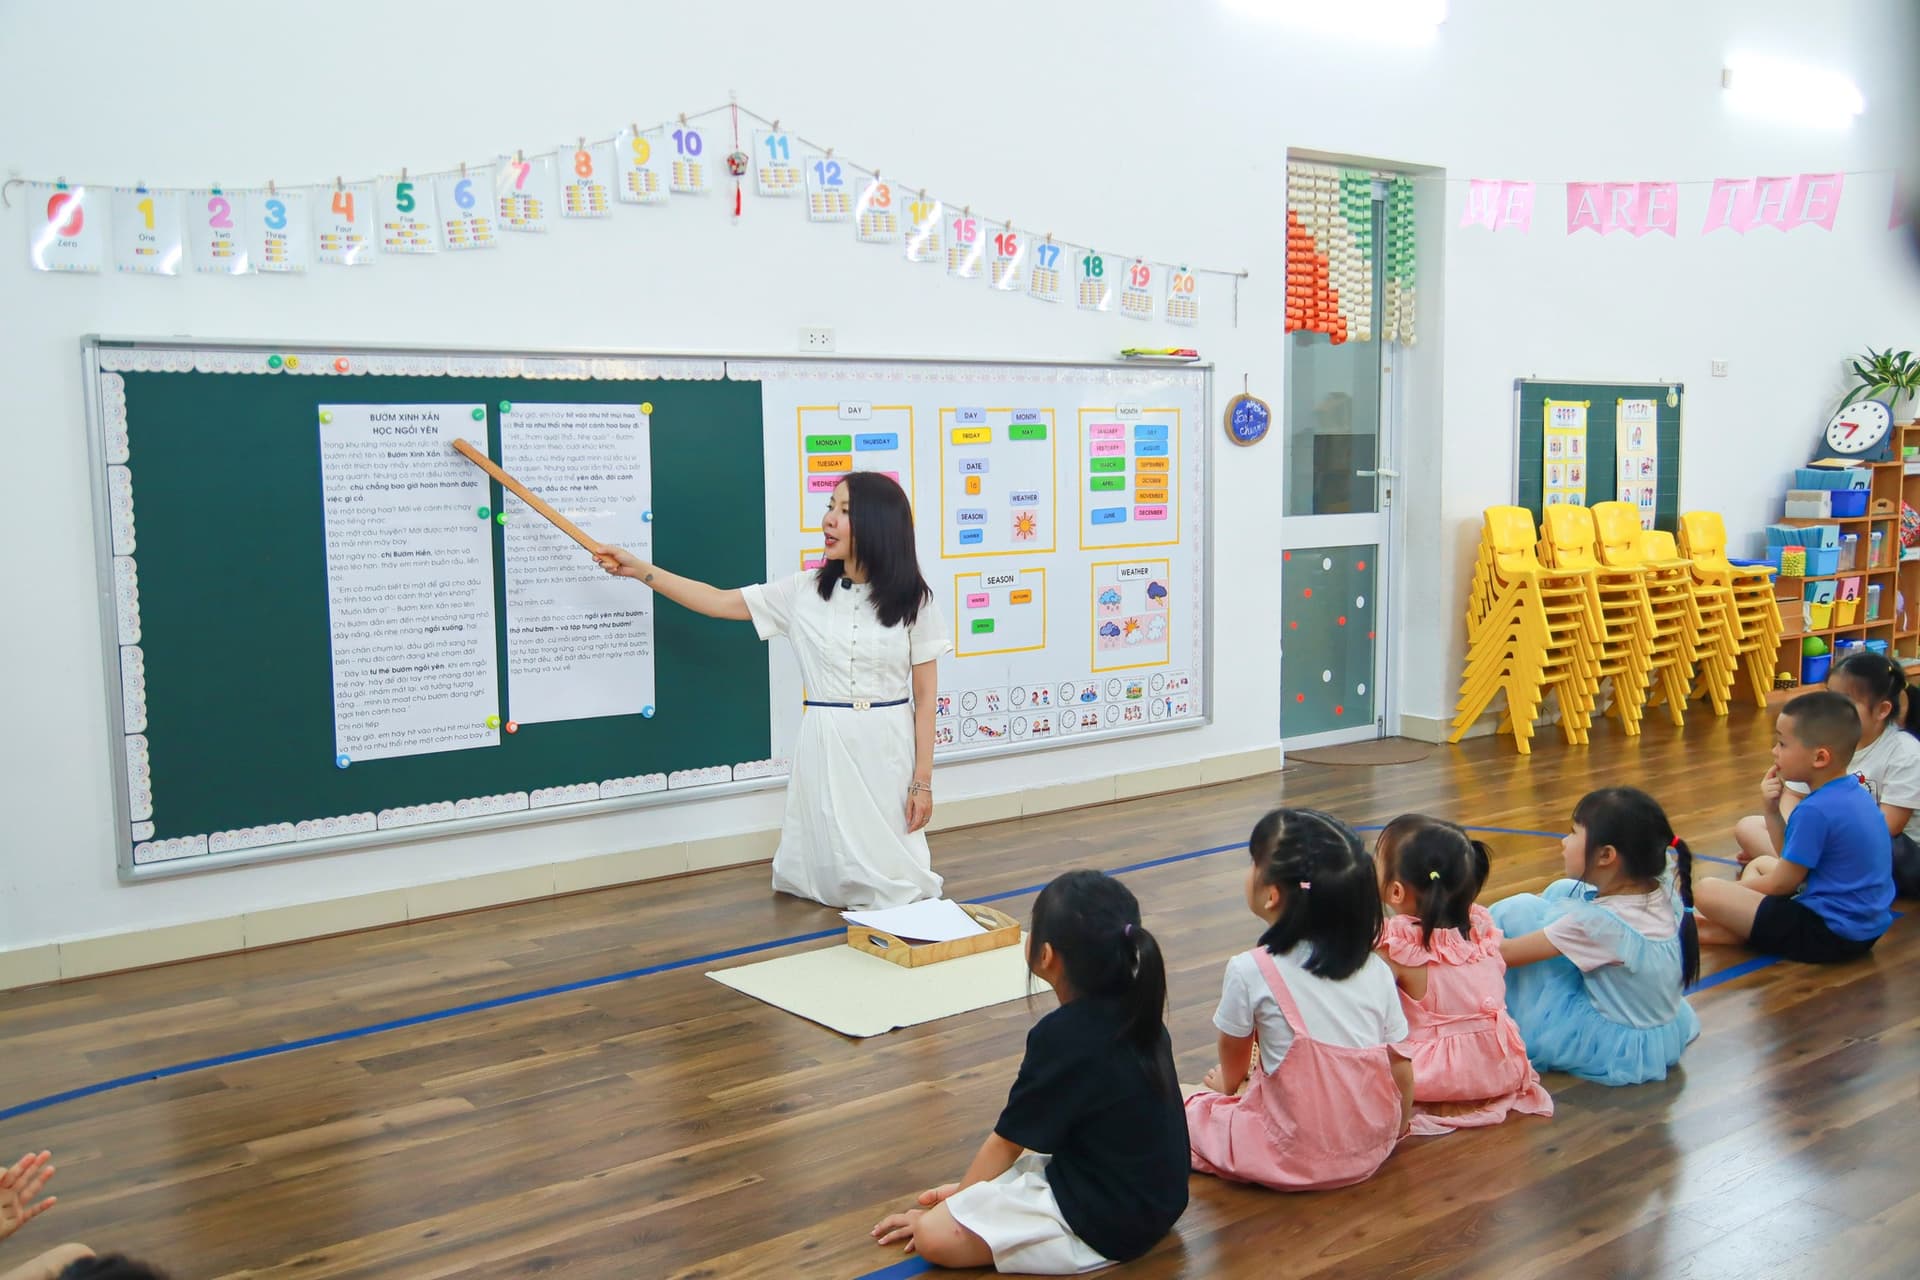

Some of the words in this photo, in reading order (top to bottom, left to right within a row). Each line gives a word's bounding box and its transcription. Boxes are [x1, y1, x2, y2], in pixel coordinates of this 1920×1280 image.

[631, 137, 651, 165] 9
[672, 129, 703, 157] 10
[765, 135, 790, 160] 11
[512, 161, 531, 190] 7
[575, 150, 593, 178] 8
[814, 160, 843, 185] 12
[395, 181, 416, 213] 5
[454, 178, 475, 209] 6
[1467, 187, 1528, 224] WE
[1718, 181, 1835, 225] THE
[47, 192, 84, 237] 0
[137, 197, 155, 230] 1
[208, 197, 234, 229] 2
[264, 199, 287, 230] 3
[331, 192, 354, 224] 4
[1572, 188, 1671, 228] ARE
[138, 233, 155, 242] One
[215, 231, 230, 239] Two
[265, 231, 287, 240] Three
[335, 224, 352, 233] Four
[953, 218, 977, 242] 15
[58, 239, 78, 248] Zero
[994, 233, 1017, 257] 16
[1037, 244, 1060, 268] 17
[1082, 255, 1104, 278] 18
[1129, 264, 1151, 287] 19
[1173, 273, 1195, 294] 20
[373, 427, 392, 435] HỌC
[987, 575, 1014, 585] SEASON
[1121, 567, 1149, 577] WEATHER
